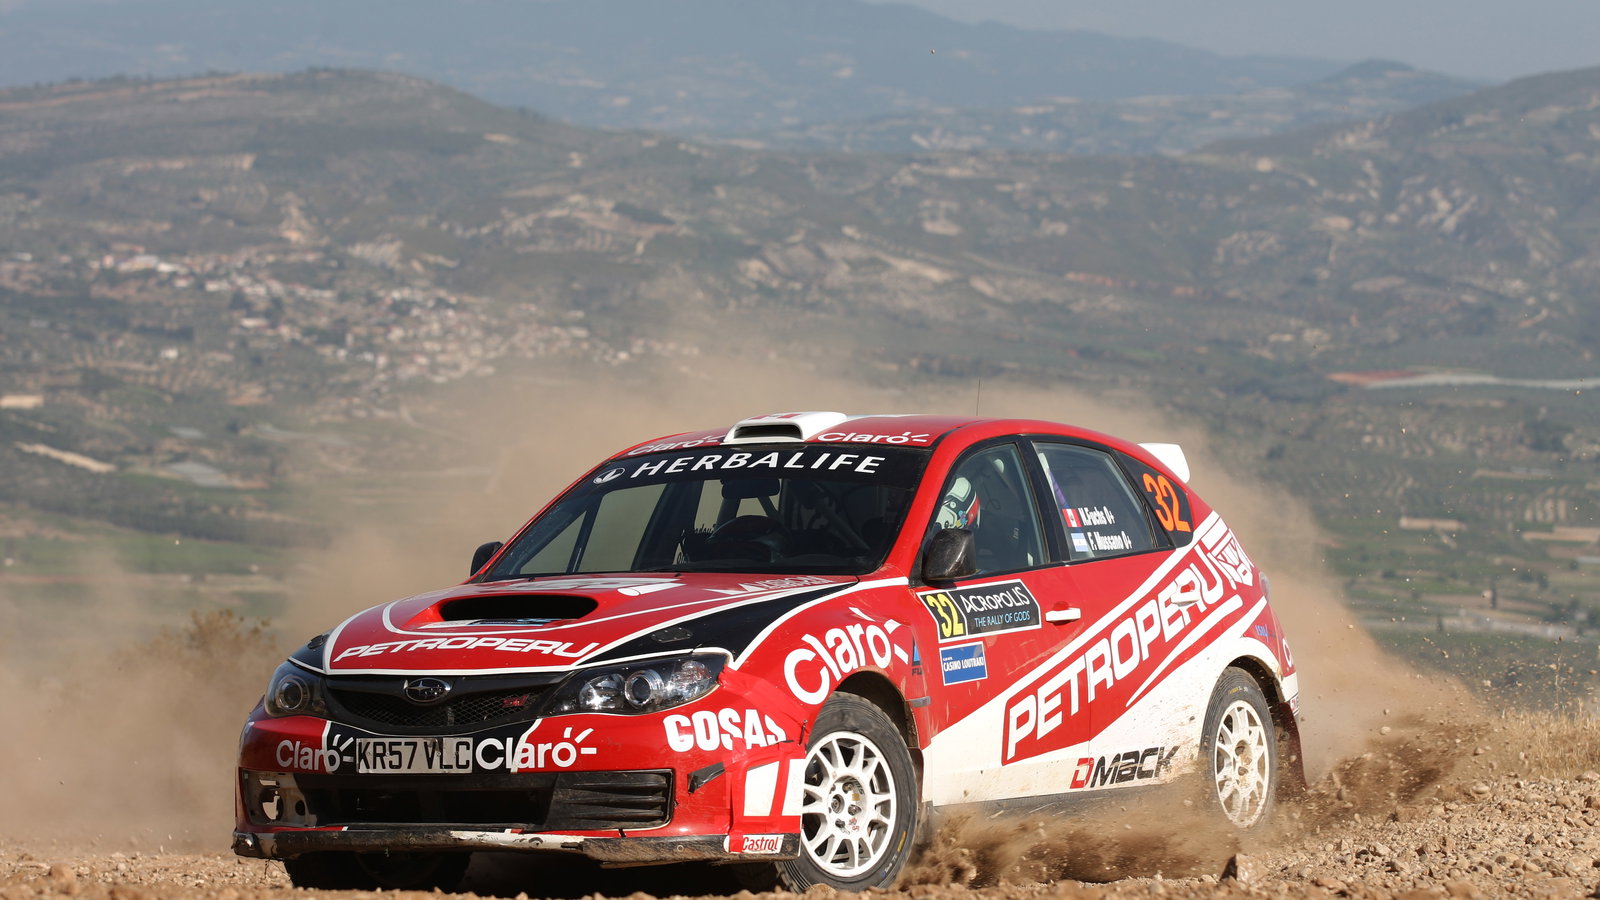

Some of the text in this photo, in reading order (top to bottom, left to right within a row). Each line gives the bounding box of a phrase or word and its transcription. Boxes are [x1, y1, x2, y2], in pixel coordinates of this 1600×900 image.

[628, 440, 704, 456] Claro
[818, 432, 910, 444] Claro
[630, 452, 886, 479] HERBALIFE
[1143, 473, 1191, 532] 32
[959, 586, 1031, 613] ACROPOLIS
[926, 593, 965, 638] 32
[974, 610, 1031, 628] THE RALLY OF GODS
[333, 636, 600, 663] PETROPERU
[784, 621, 892, 705] Claro
[1007, 543, 1224, 761] PETROPERU
[943, 660, 961, 672] CASINO
[663, 708, 787, 752] COSAS
[276, 739, 341, 774] Claro
[358, 741, 471, 770] KR57 VLC
[475, 736, 577, 770] Claro
[742, 836, 779, 851] Castrol
